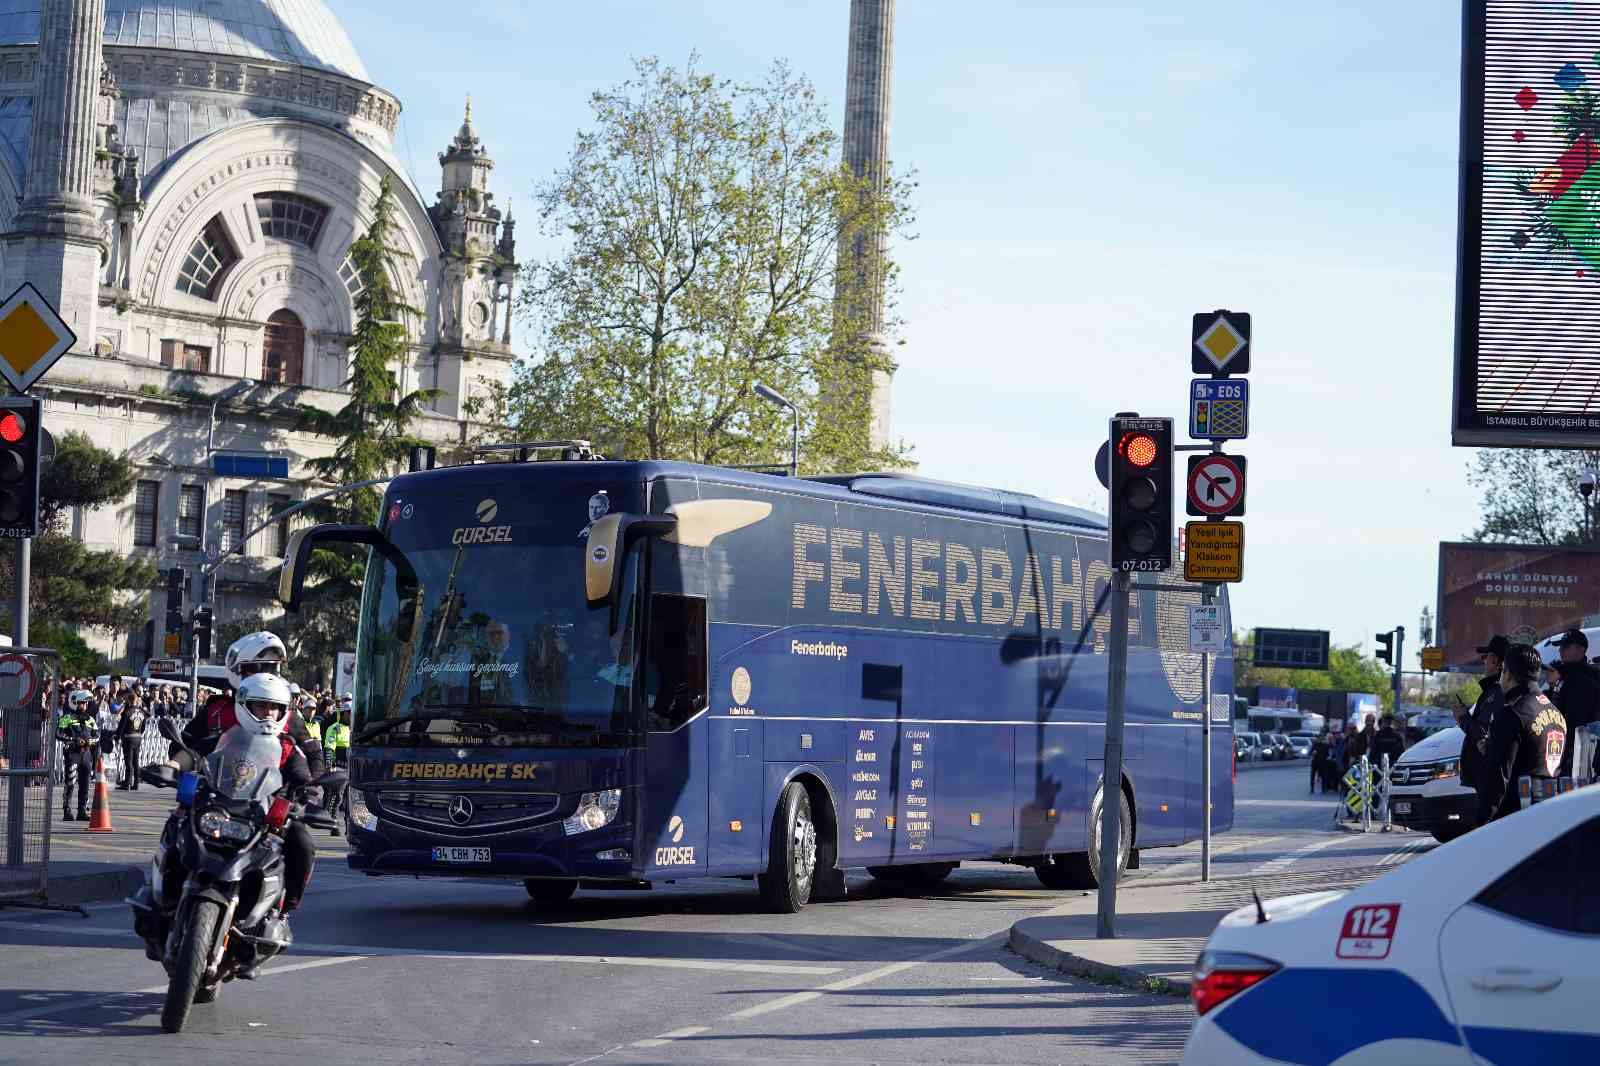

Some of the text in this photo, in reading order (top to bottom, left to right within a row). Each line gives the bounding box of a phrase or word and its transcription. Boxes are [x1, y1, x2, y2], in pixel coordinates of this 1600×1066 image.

[1218, 386, 1241, 398] EDS
[1486, 416, 1528, 425] İSTANBUL
[1530, 416, 1587, 428] BÜYÜKŞEHİR
[452, 525, 513, 544] GÜRSEL
[1195, 527, 1234, 538] Yeşil Işık
[1190, 539, 1239, 551] Yandığında
[1196, 551, 1233, 561] Klakson
[1122, 560, 1161, 571] 07-012
[791, 639, 848, 661] Fenerbahçe
[859, 729, 875, 742] AVIS
[392, 763, 537, 782] FENERBAHÇE SK
[436, 847, 491, 862] 34 CBH 753
[655, 846, 697, 866] GÜRSEL
[1351, 908, 1391, 935] 112
